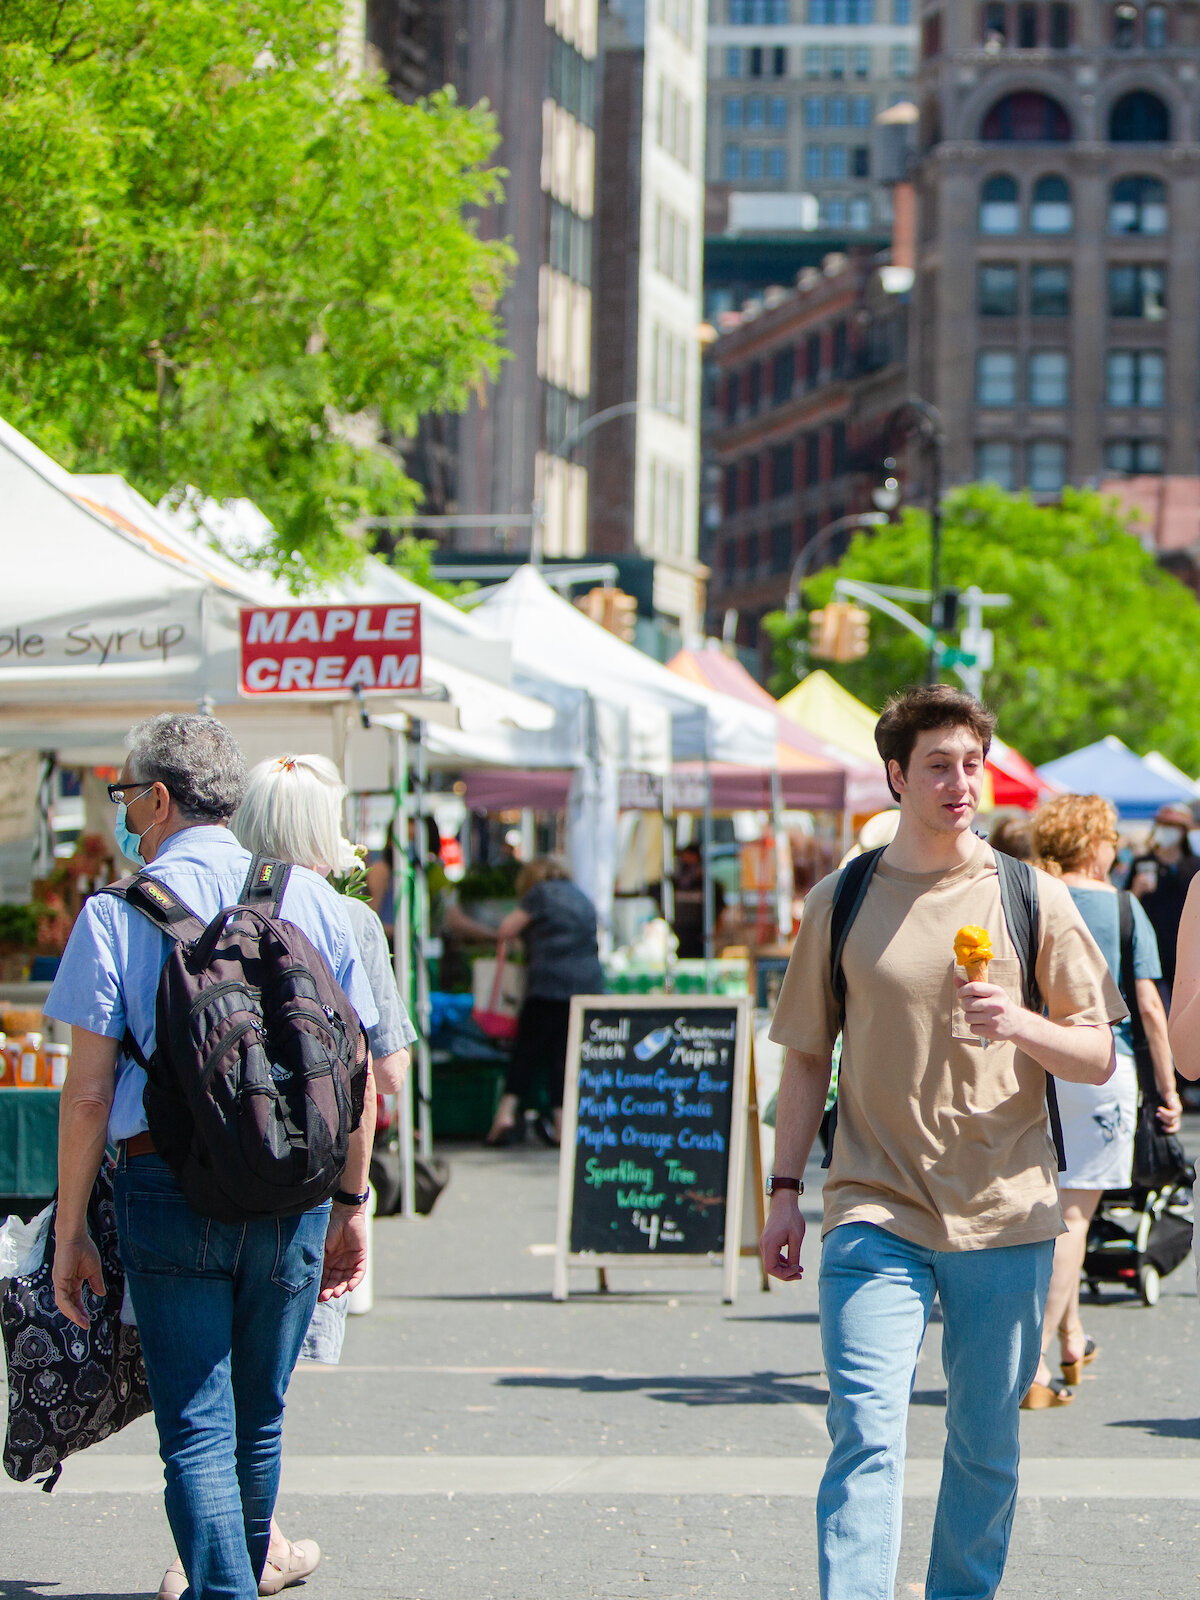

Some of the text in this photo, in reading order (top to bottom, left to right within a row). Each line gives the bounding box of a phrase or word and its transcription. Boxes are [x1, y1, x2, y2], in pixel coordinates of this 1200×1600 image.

[245, 607, 416, 644] MAPLE
[64, 623, 185, 669] Syrup
[244, 654, 421, 690] CREAM
[589, 1017, 631, 1042] Small
[581, 1040, 627, 1062] Batch
[577, 1068, 613, 1096] Maple
[616, 1068, 654, 1089] Lemon
[577, 1095, 713, 1123] Maple Cream Soda
[575, 1124, 725, 1158] Maple Orange Crush
[583, 1157, 697, 1193] Sparkling Tree
[616, 1189, 667, 1209] Water
